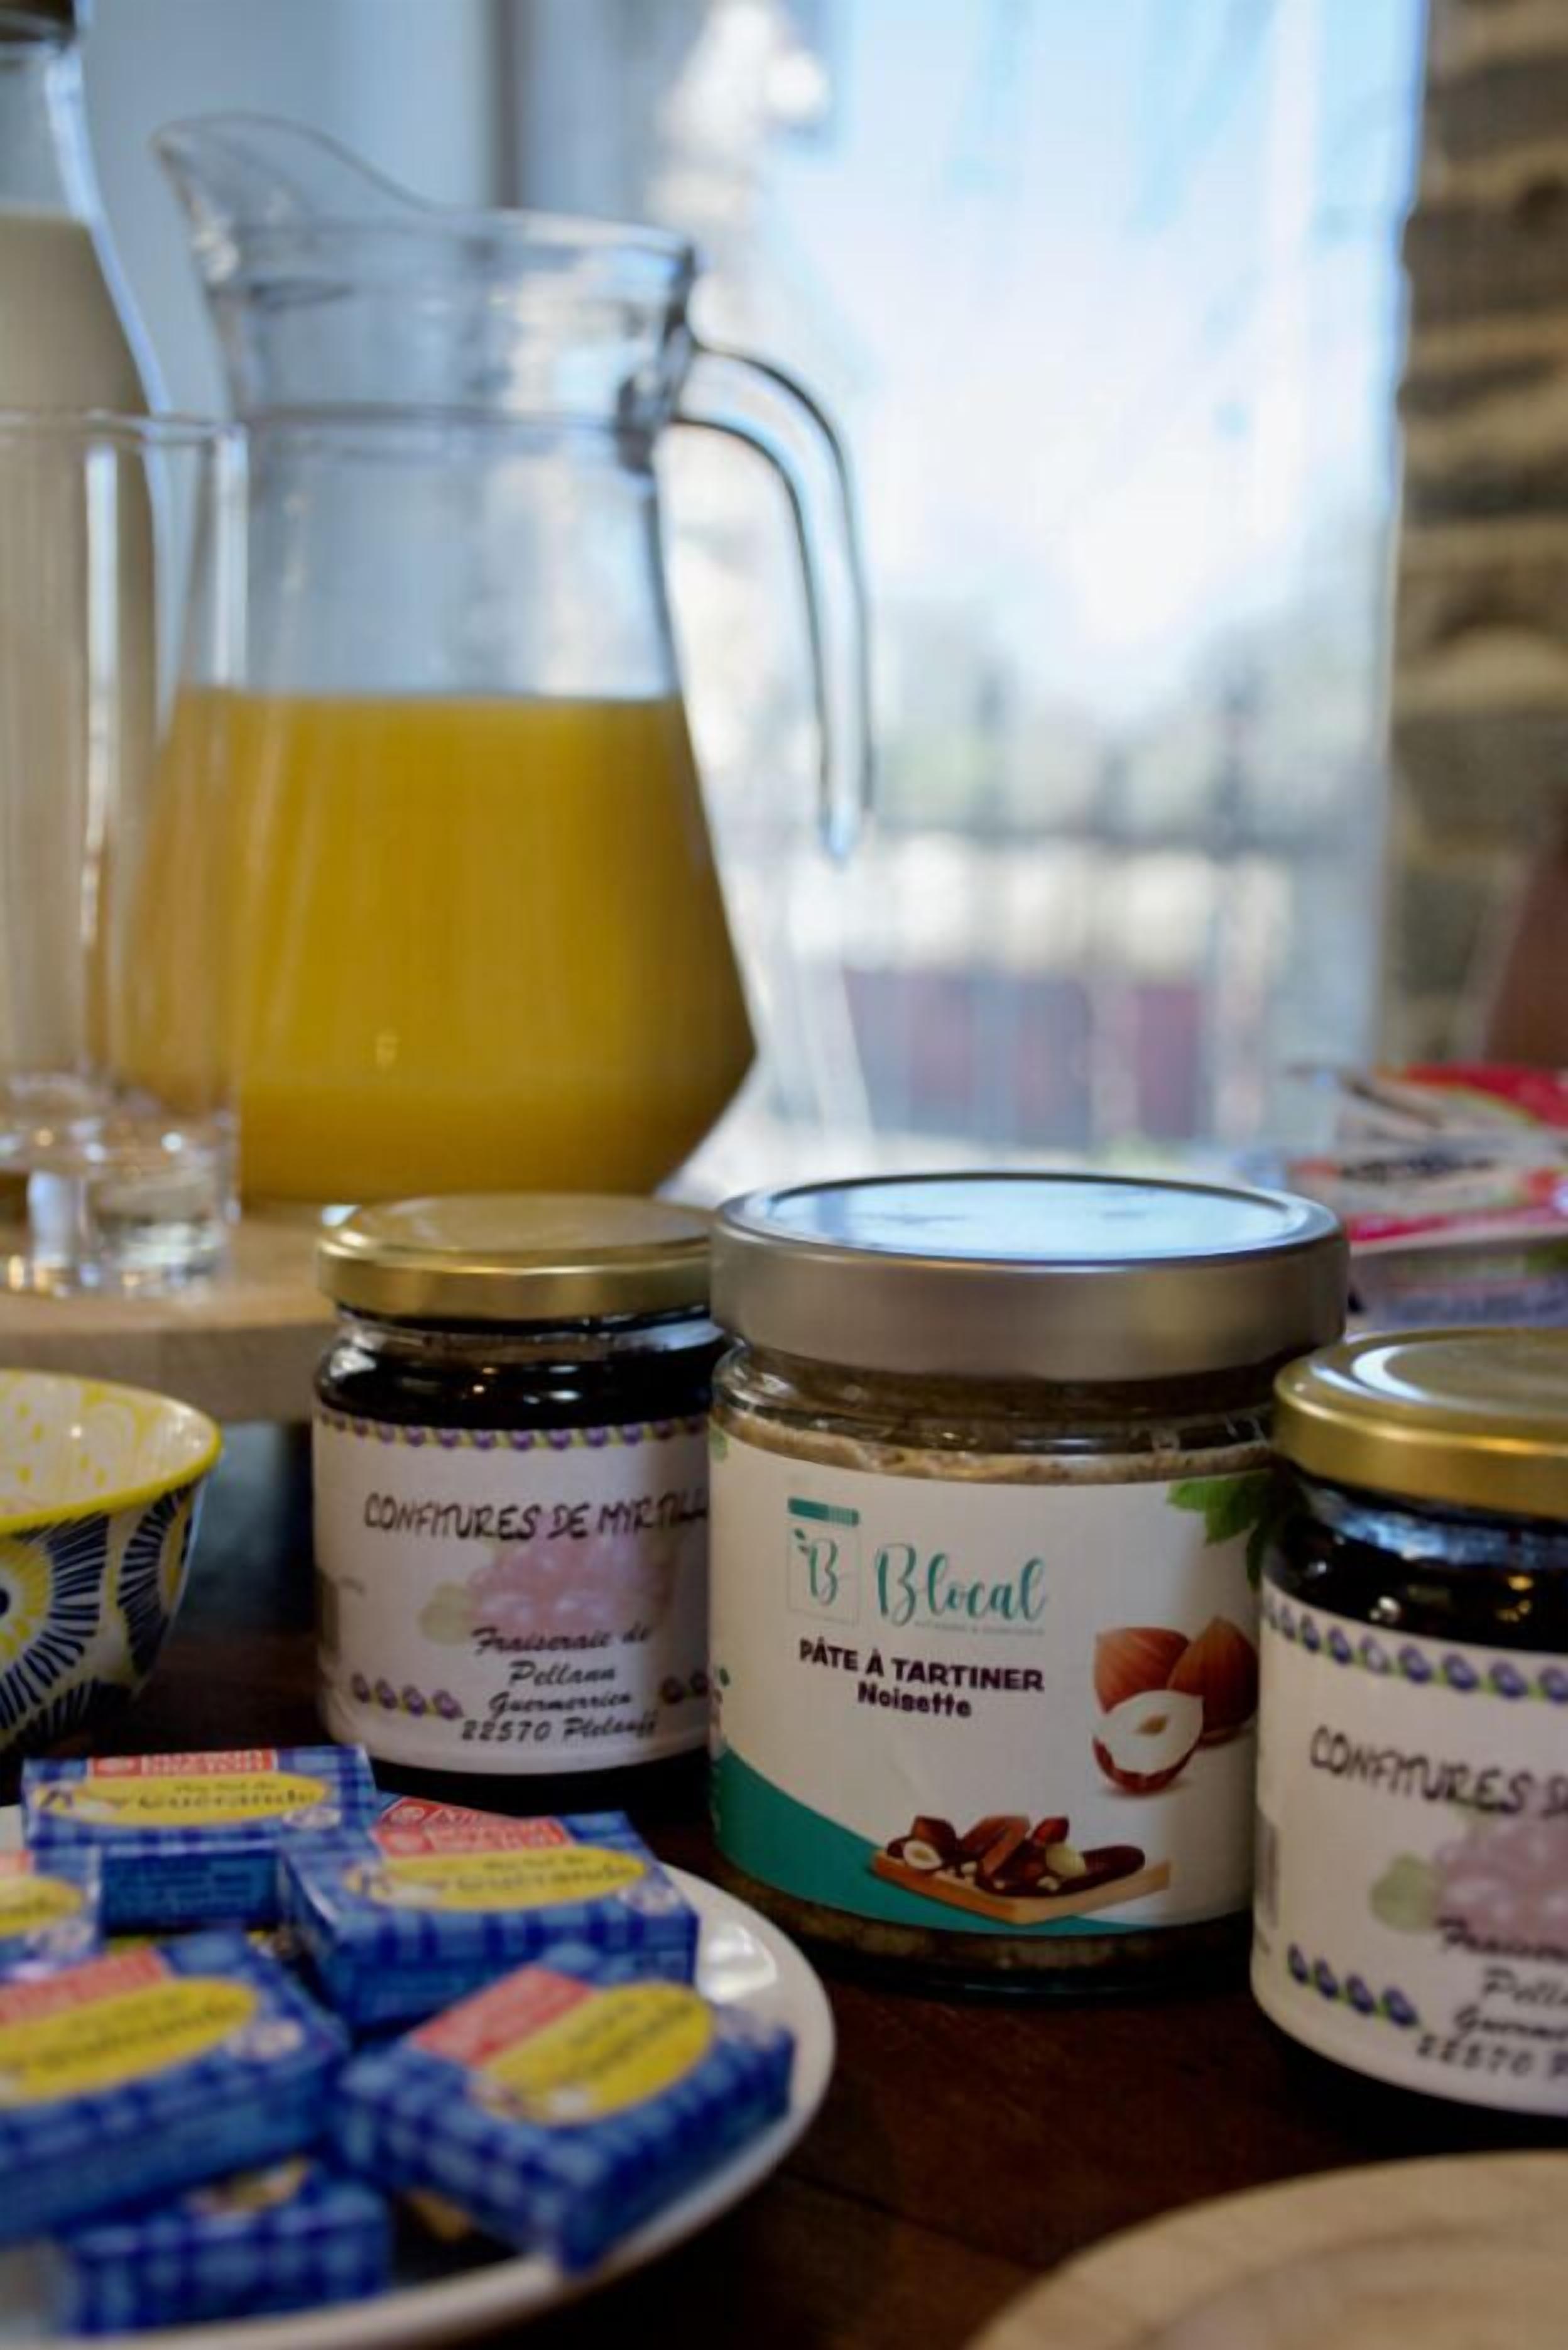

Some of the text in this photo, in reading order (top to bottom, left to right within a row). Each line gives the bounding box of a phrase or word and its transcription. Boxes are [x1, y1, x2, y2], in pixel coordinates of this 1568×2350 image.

[364, 1493, 538, 1539] CONFITURES
[547, 1500, 591, 1539] DE
[875, 1543, 1046, 1627] Blocal
[799, 1635, 1045, 1691] PÂTE À TARTINER
[857, 1680, 973, 1717] Noisette
[461, 1720, 552, 1742] 22570
[1310, 1724, 1533, 1815] CONFITURES
